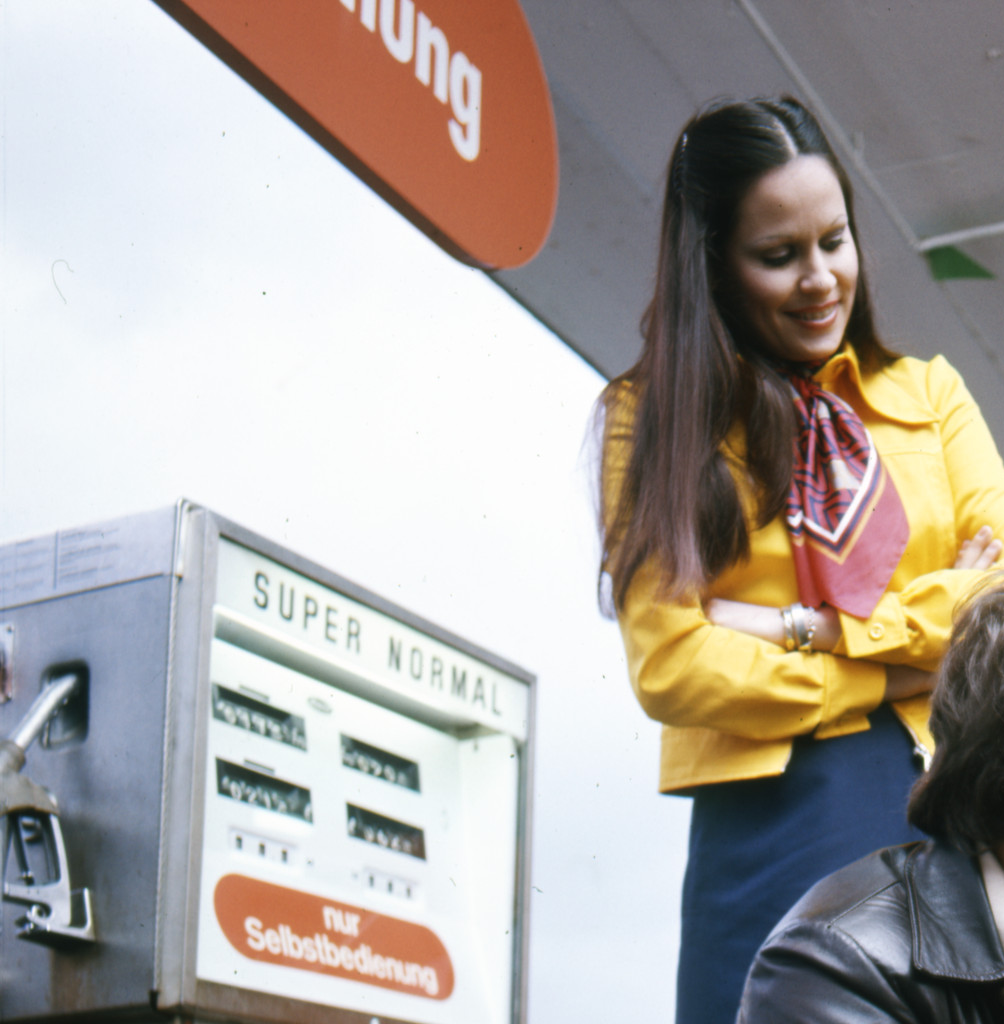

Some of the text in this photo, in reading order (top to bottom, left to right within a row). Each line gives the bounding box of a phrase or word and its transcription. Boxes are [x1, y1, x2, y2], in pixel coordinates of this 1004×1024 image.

[339, 0, 482, 162] ung
[253, 572, 502, 716] SUPER NORMAL
[244, 917, 438, 996] Selbstbedienung
[323, 905, 361, 938] nur
